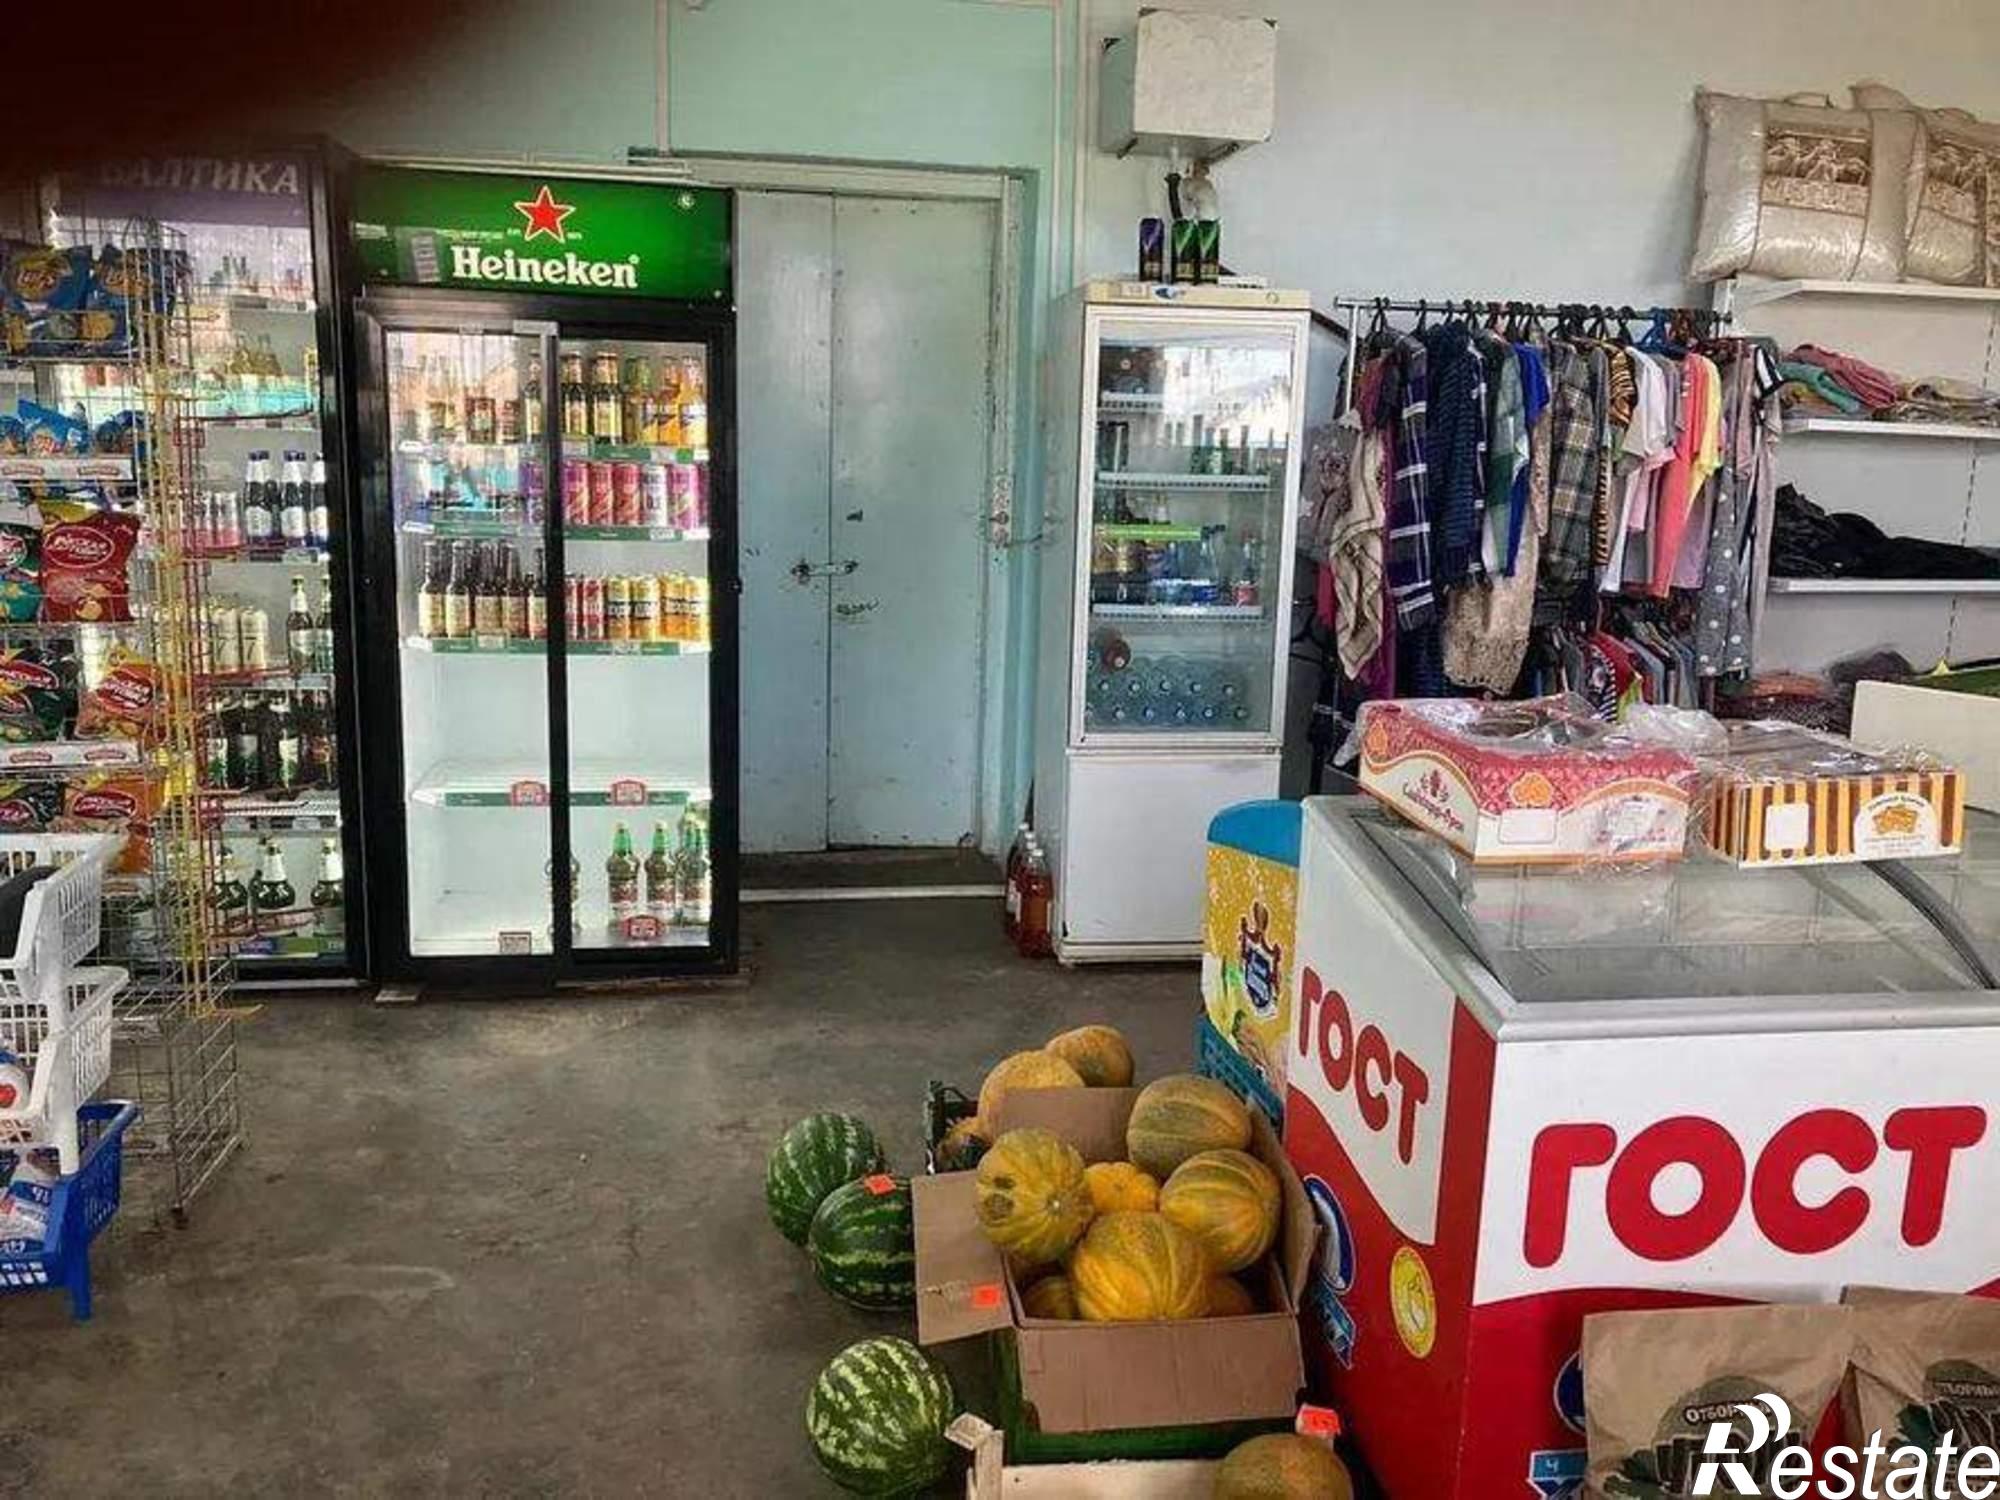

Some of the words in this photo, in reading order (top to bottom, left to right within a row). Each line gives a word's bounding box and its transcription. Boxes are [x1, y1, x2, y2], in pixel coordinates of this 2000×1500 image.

[450, 245, 638, 288] Heineken
[1299, 967, 1429, 1166] ГОСТ
[1523, 1105, 1988, 1269] ГОСТ
